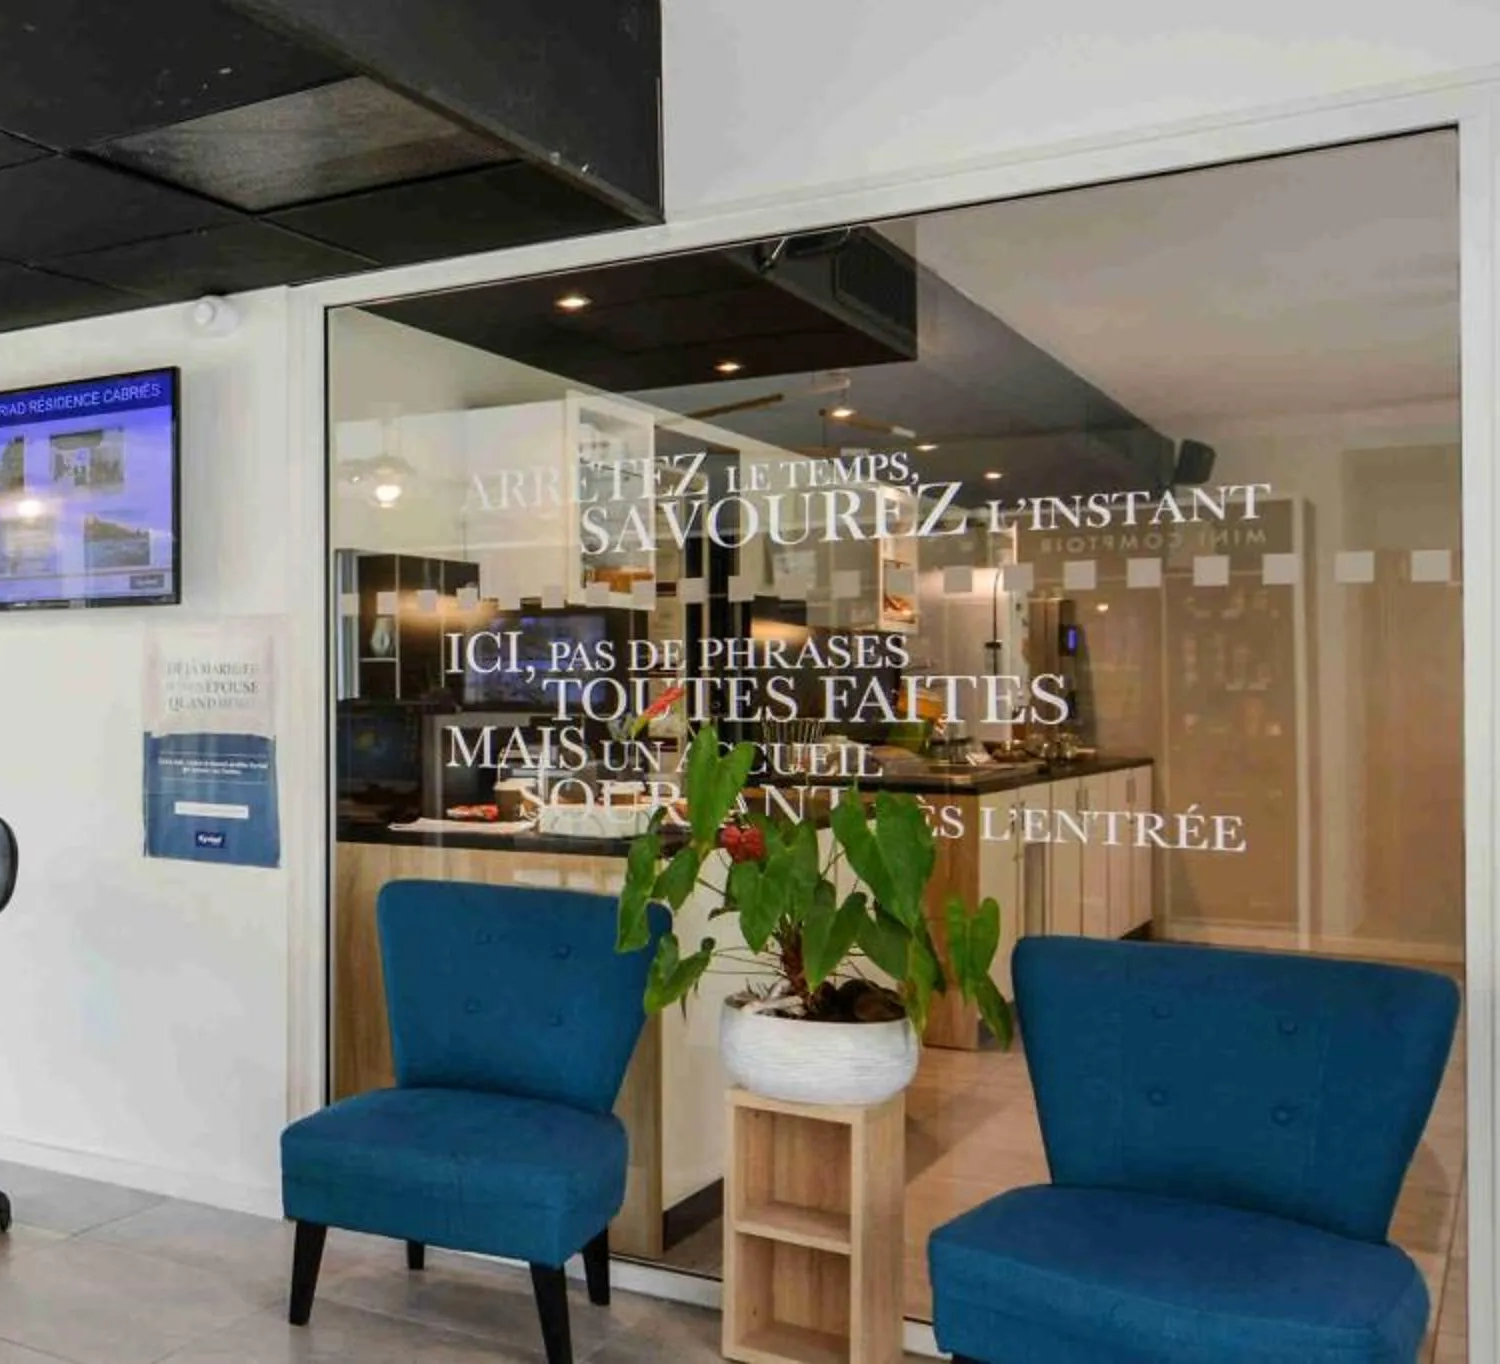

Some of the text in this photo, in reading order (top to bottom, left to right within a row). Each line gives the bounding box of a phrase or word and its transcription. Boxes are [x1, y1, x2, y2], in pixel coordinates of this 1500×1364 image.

[726, 464, 771, 493] LE
[780, 451, 919, 488] TEMPS,
[580, 481, 1272, 555] SAVOUREZ L'INSTANT
[444, 631, 910, 684] ICI, PAS DE PHRASES
[541, 673, 1070, 726] TOUTES FAITES
[445, 725, 884, 778] MAIS UN CUEIL
[980, 804, 1248, 853] L'ENTRÉE
